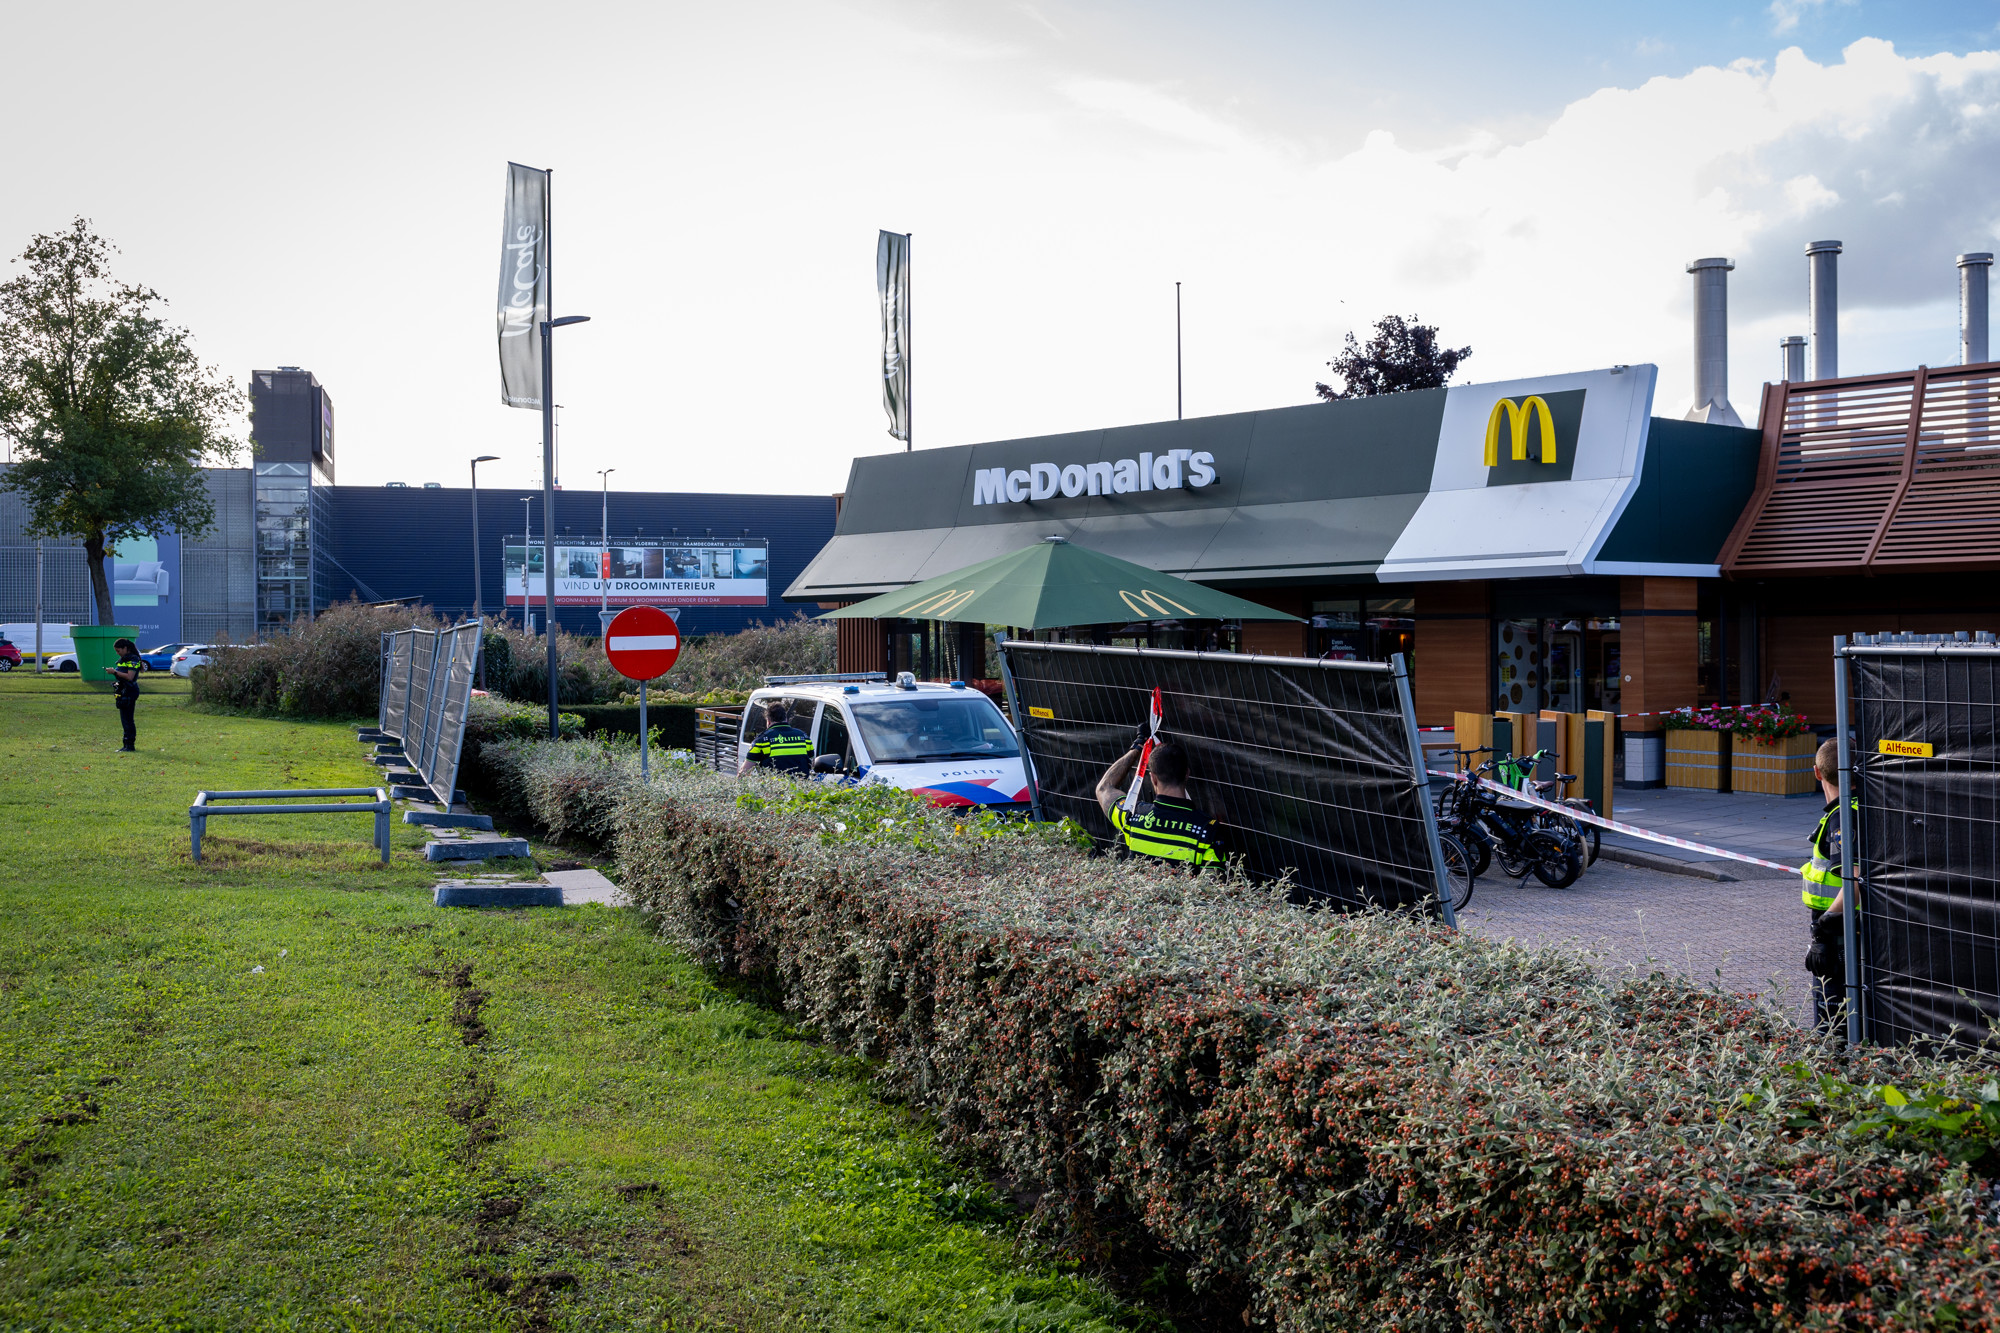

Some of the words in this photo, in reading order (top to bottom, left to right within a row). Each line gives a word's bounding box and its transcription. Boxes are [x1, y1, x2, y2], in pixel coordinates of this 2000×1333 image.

[973, 448, 1216, 506] McDonald's
[563, 582, 590, 590] VIND
[593, 582, 612, 590] UW
[615, 582, 716, 591] DROOMINTERIEUR
[941, 769, 1005, 778] POLITIE
[1138, 813, 1193, 832] POLITIE
